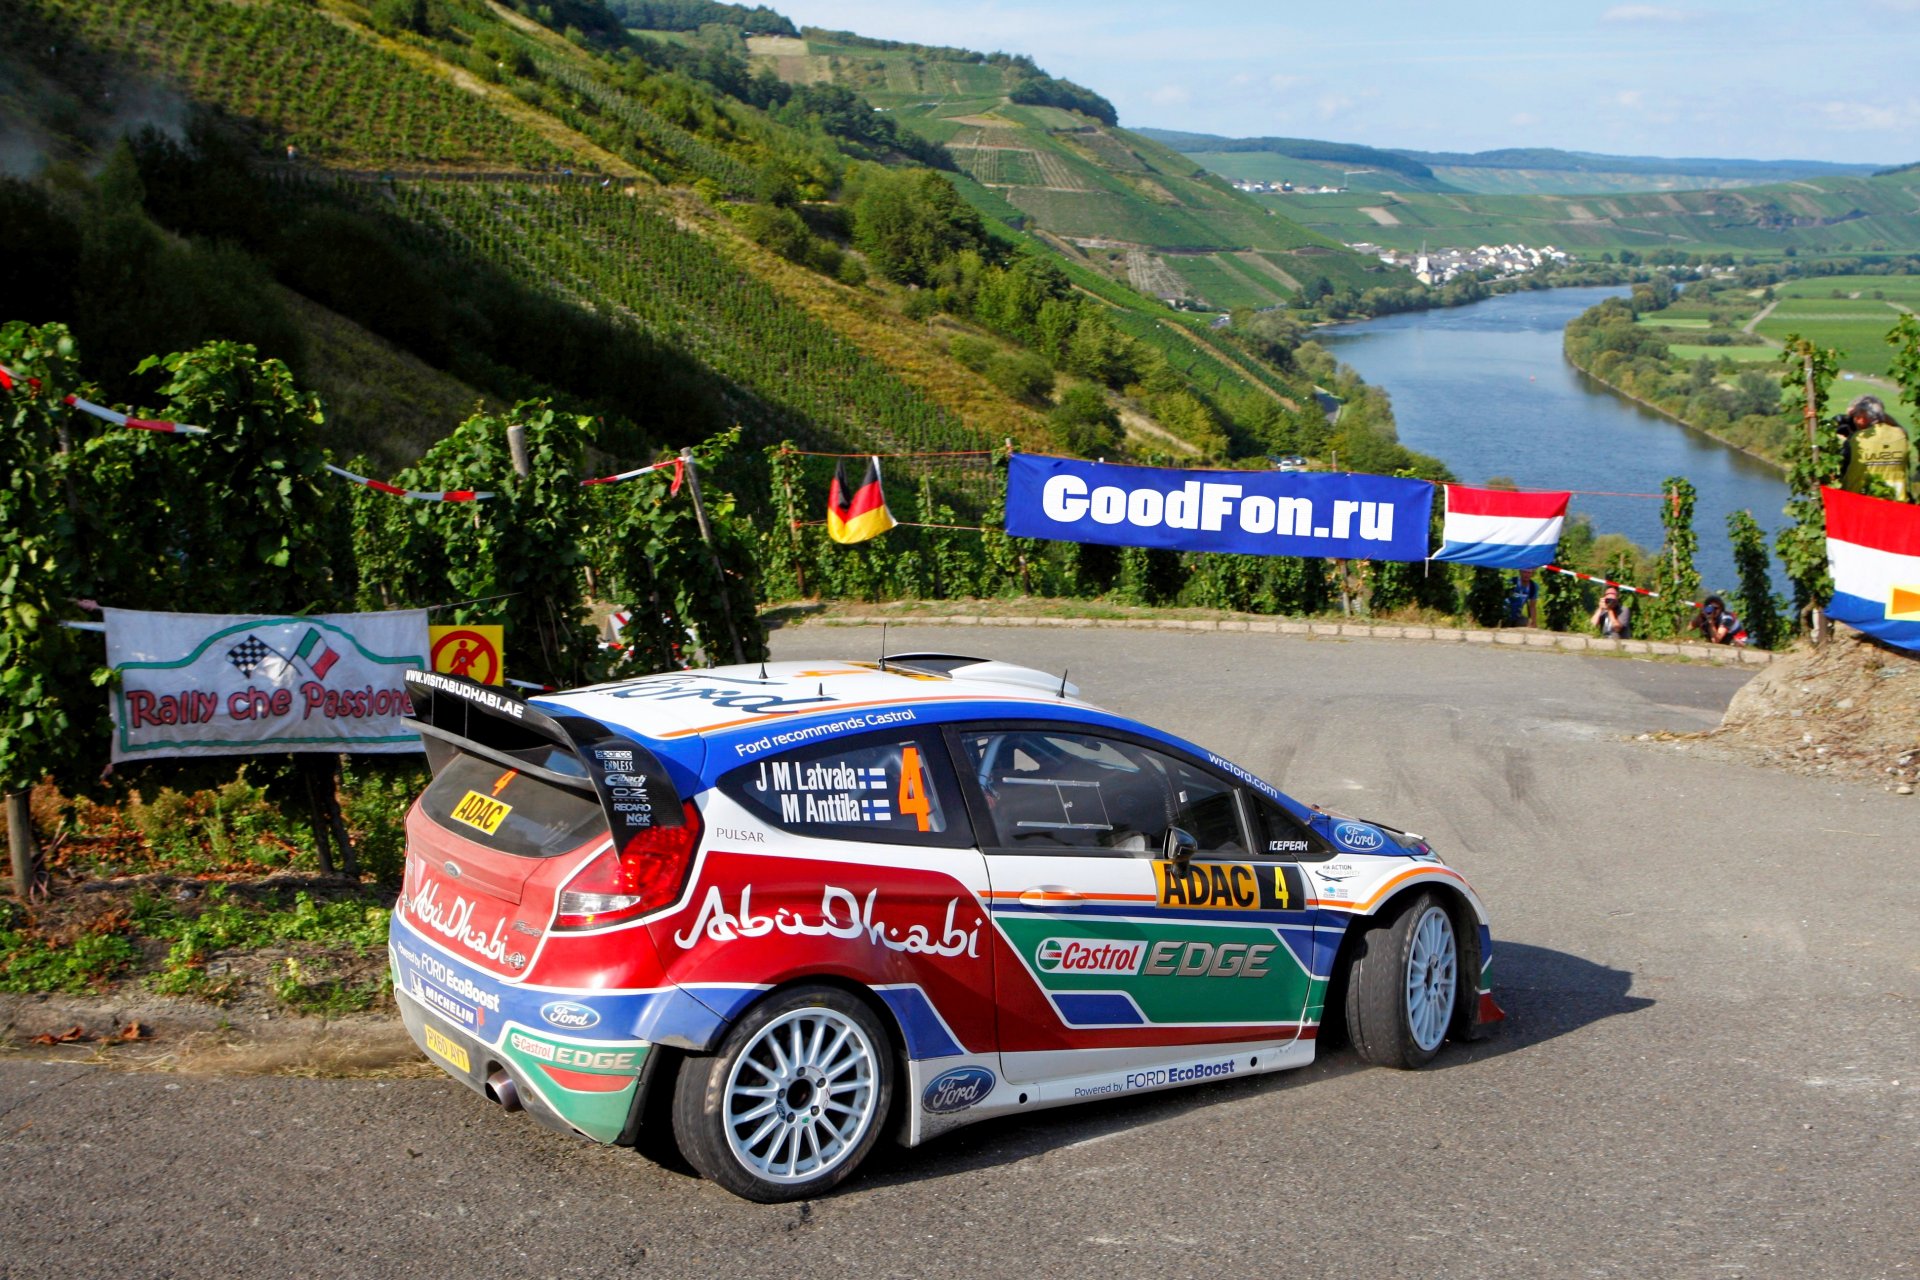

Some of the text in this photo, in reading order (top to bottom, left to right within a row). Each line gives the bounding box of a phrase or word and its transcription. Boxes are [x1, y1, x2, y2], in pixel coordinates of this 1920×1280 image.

[1042, 474, 1394, 541] GoodFon.ru
[126, 681, 414, 728] Rally che Passione
[405, 669, 524, 719] WWW.VISITABUDHABI.AE
[734, 709, 916, 757] Ford recommends Castrol
[491, 768, 519, 797] 4
[604, 760, 633, 771] ENDLESS
[604, 773, 646, 787] Eibach
[756, 761, 857, 792] J M Latvala
[1208, 753, 1278, 799] wrcford.com
[898, 747, 932, 832] 4
[455, 794, 504, 830] ADAC
[613, 803, 652, 812] RECARO
[626, 813, 651, 823] NGK
[781, 793, 861, 823] M Anttila
[716, 827, 765, 843] PULSAR
[1269, 841, 1309, 851] ICEPEAK
[1344, 827, 1377, 848] Ford
[1163, 863, 1289, 908] ADAC 4
[1061, 940, 1279, 978] Castrol EDGE
[421, 953, 445, 983] FORD
[446, 969, 500, 1013] EcoBoost
[425, 986, 474, 1024] MICHELIN
[550, 1004, 587, 1026] Ford
[519, 1039, 637, 1071] Castrol EDGE
[933, 1074, 978, 1108] Ford
[1074, 1059, 1235, 1097] Powered by FORD EcoBoost
